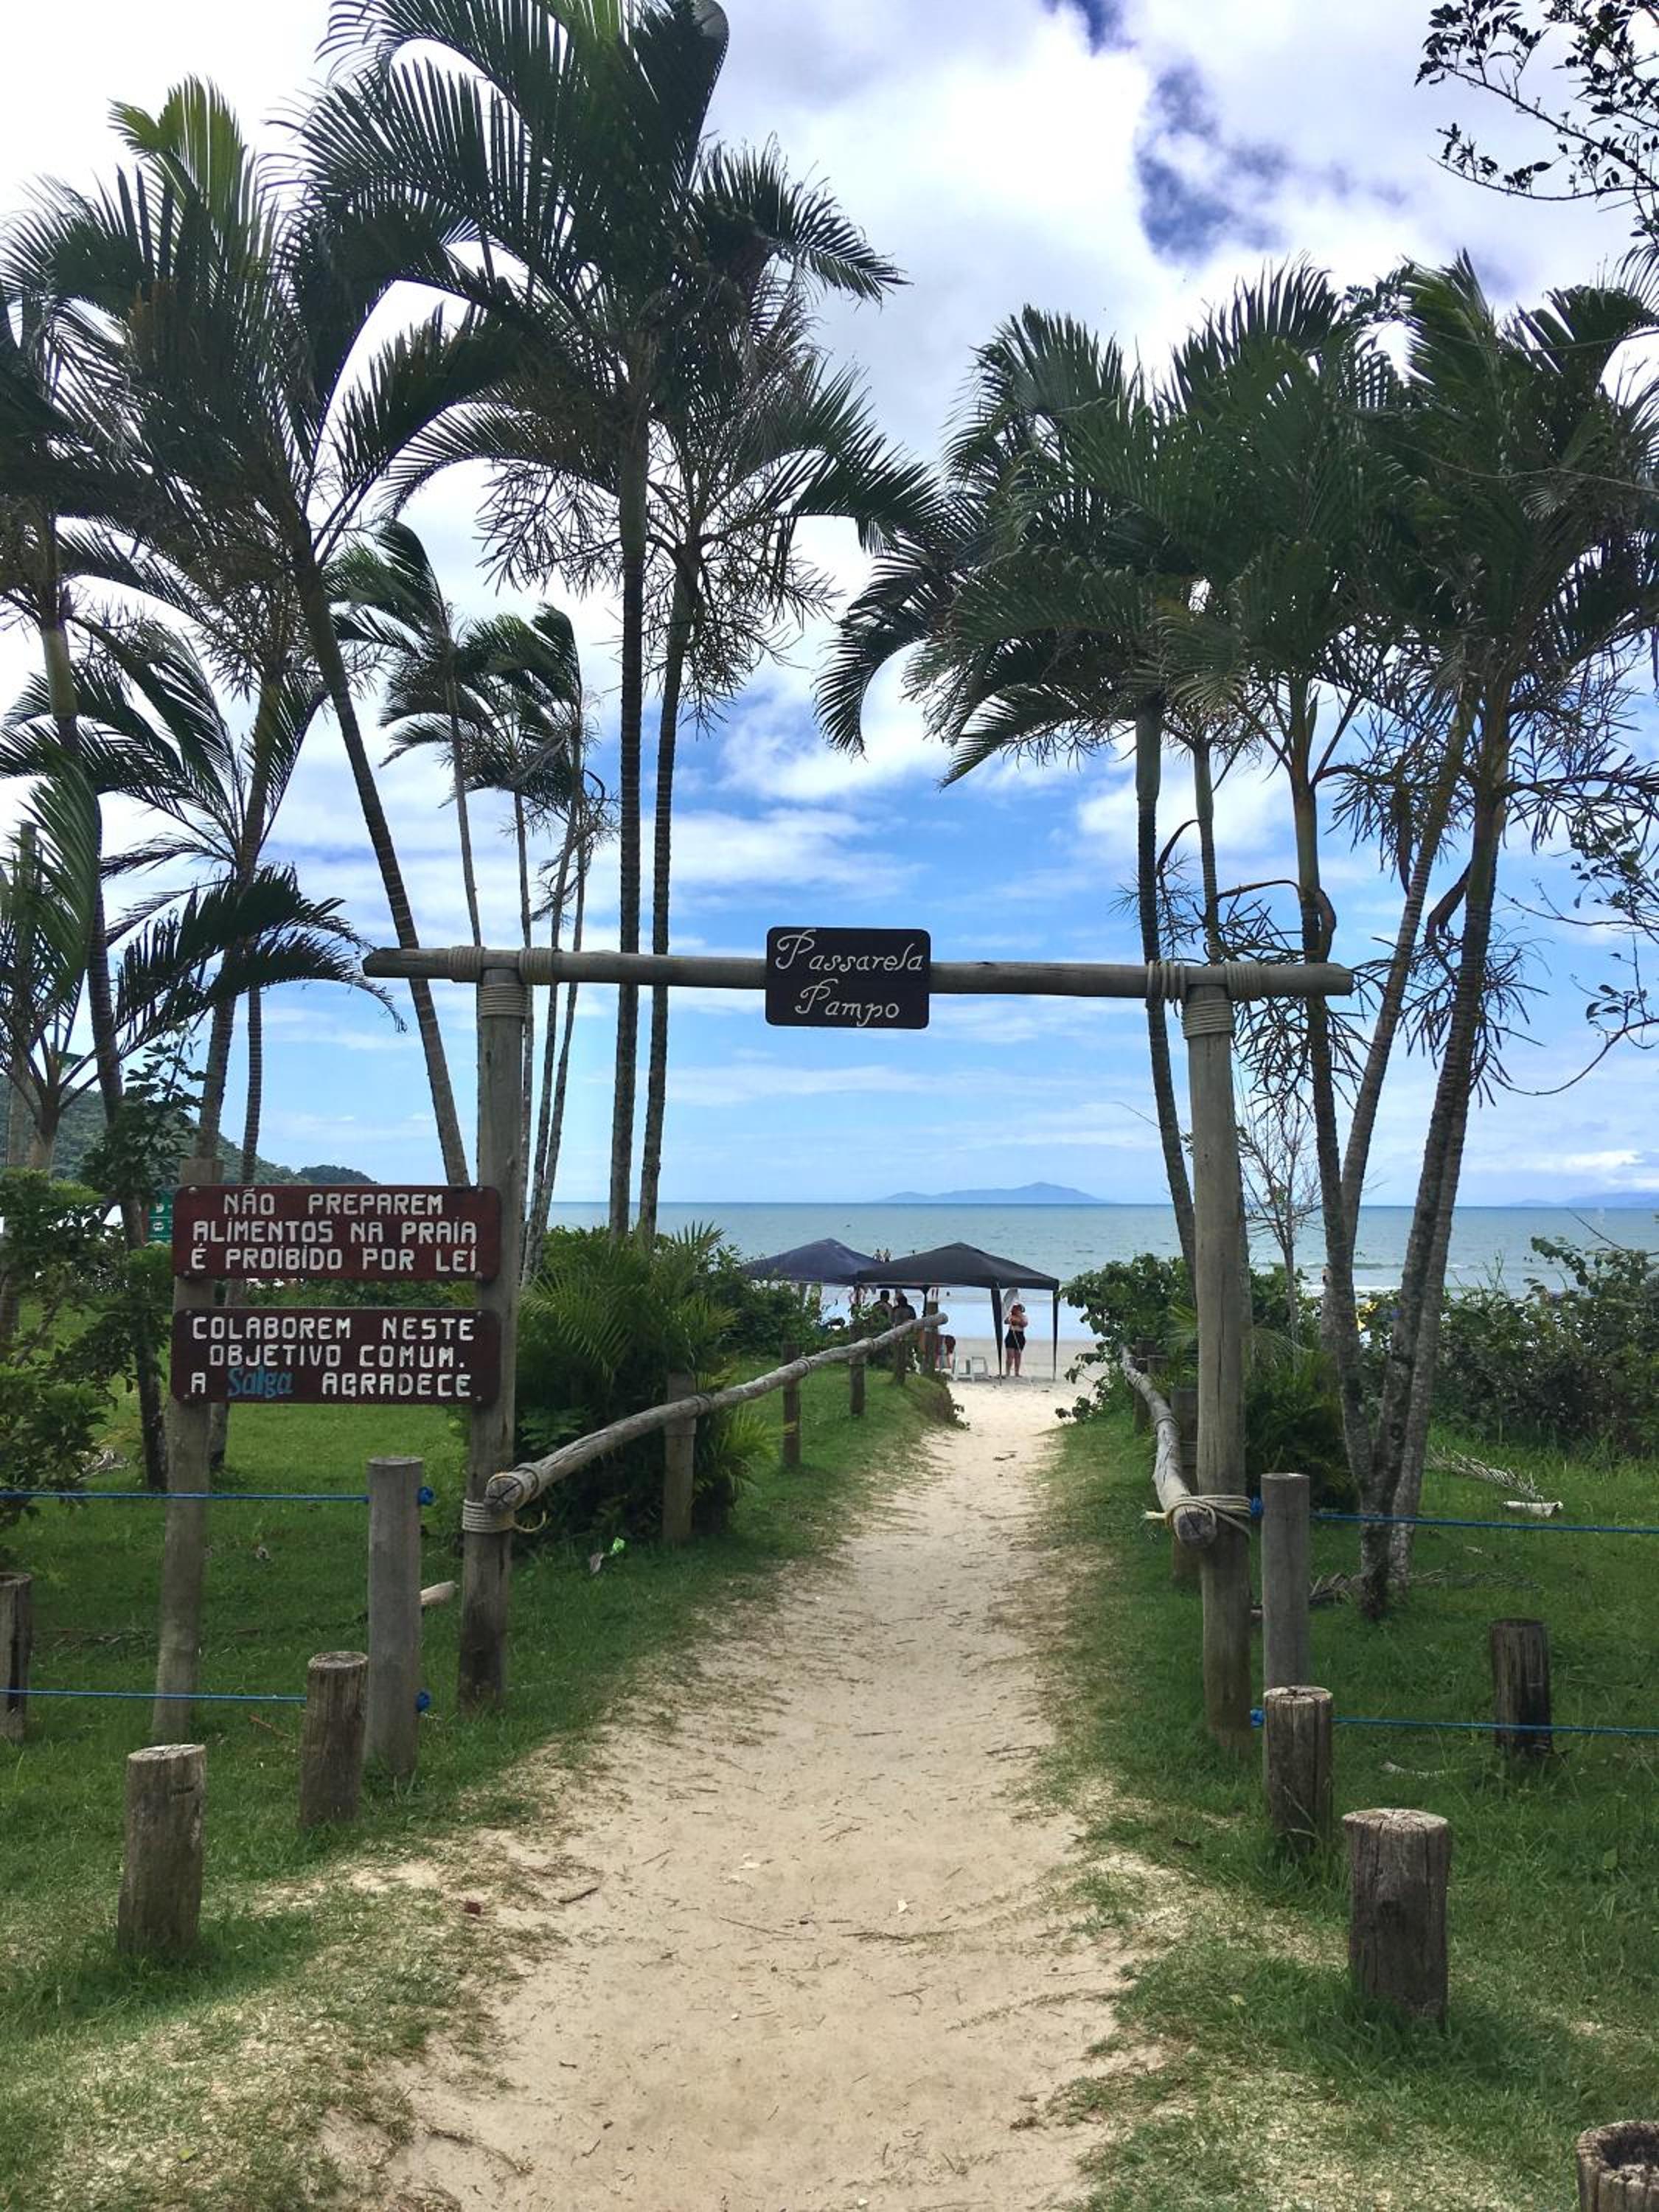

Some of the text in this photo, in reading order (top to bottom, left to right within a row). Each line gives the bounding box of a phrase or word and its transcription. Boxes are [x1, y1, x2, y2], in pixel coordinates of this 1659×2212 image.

[775, 929, 923, 972] Passarela
[794, 978, 900, 1027] Pampo
[223, 1188, 443, 1216] NÃO PREPAREM
[350, 1222, 383, 1242] NA
[191, 1243, 206, 1269] É
[362, 1248, 413, 1270] POR
[192, 1317, 474, 1341] COLABOREM NESTE
[209, 1345, 465, 1368] OBJETIVO COMUM.
[191, 1372, 206, 1394] A
[322, 1373, 471, 1397] AGRADECE
